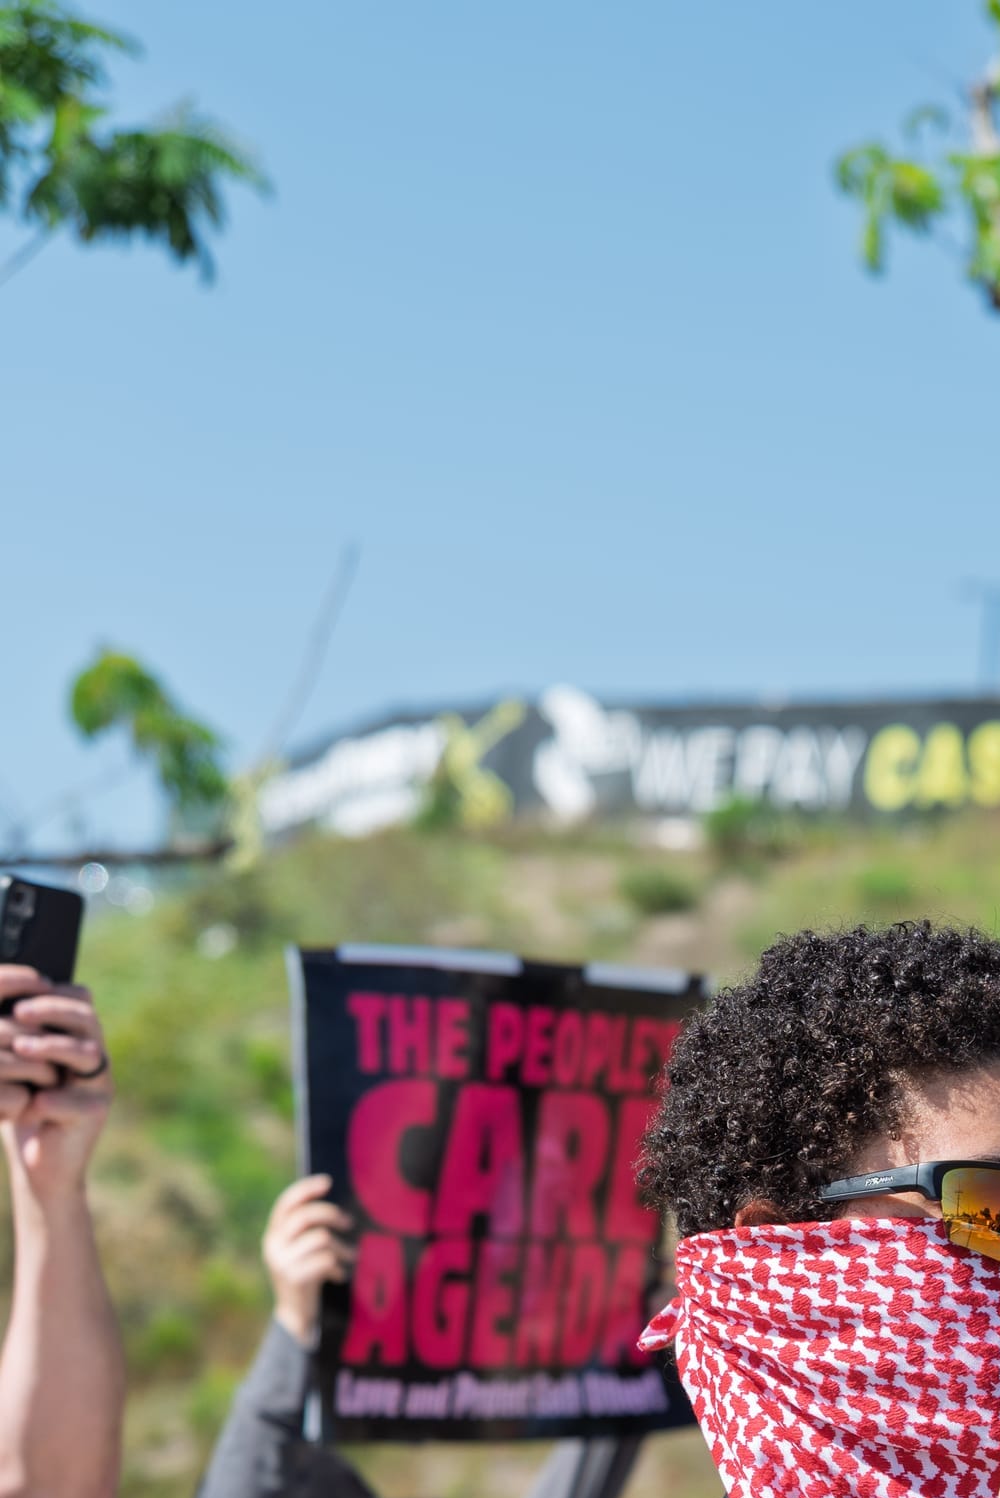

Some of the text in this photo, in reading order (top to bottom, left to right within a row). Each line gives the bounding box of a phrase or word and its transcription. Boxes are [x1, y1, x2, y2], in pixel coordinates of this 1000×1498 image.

[631, 725, 734, 811] WE
[736, 722, 866, 809] PAY
[347, 992, 470, 1079] THE
[341, 1233, 655, 1371] AGENDA
